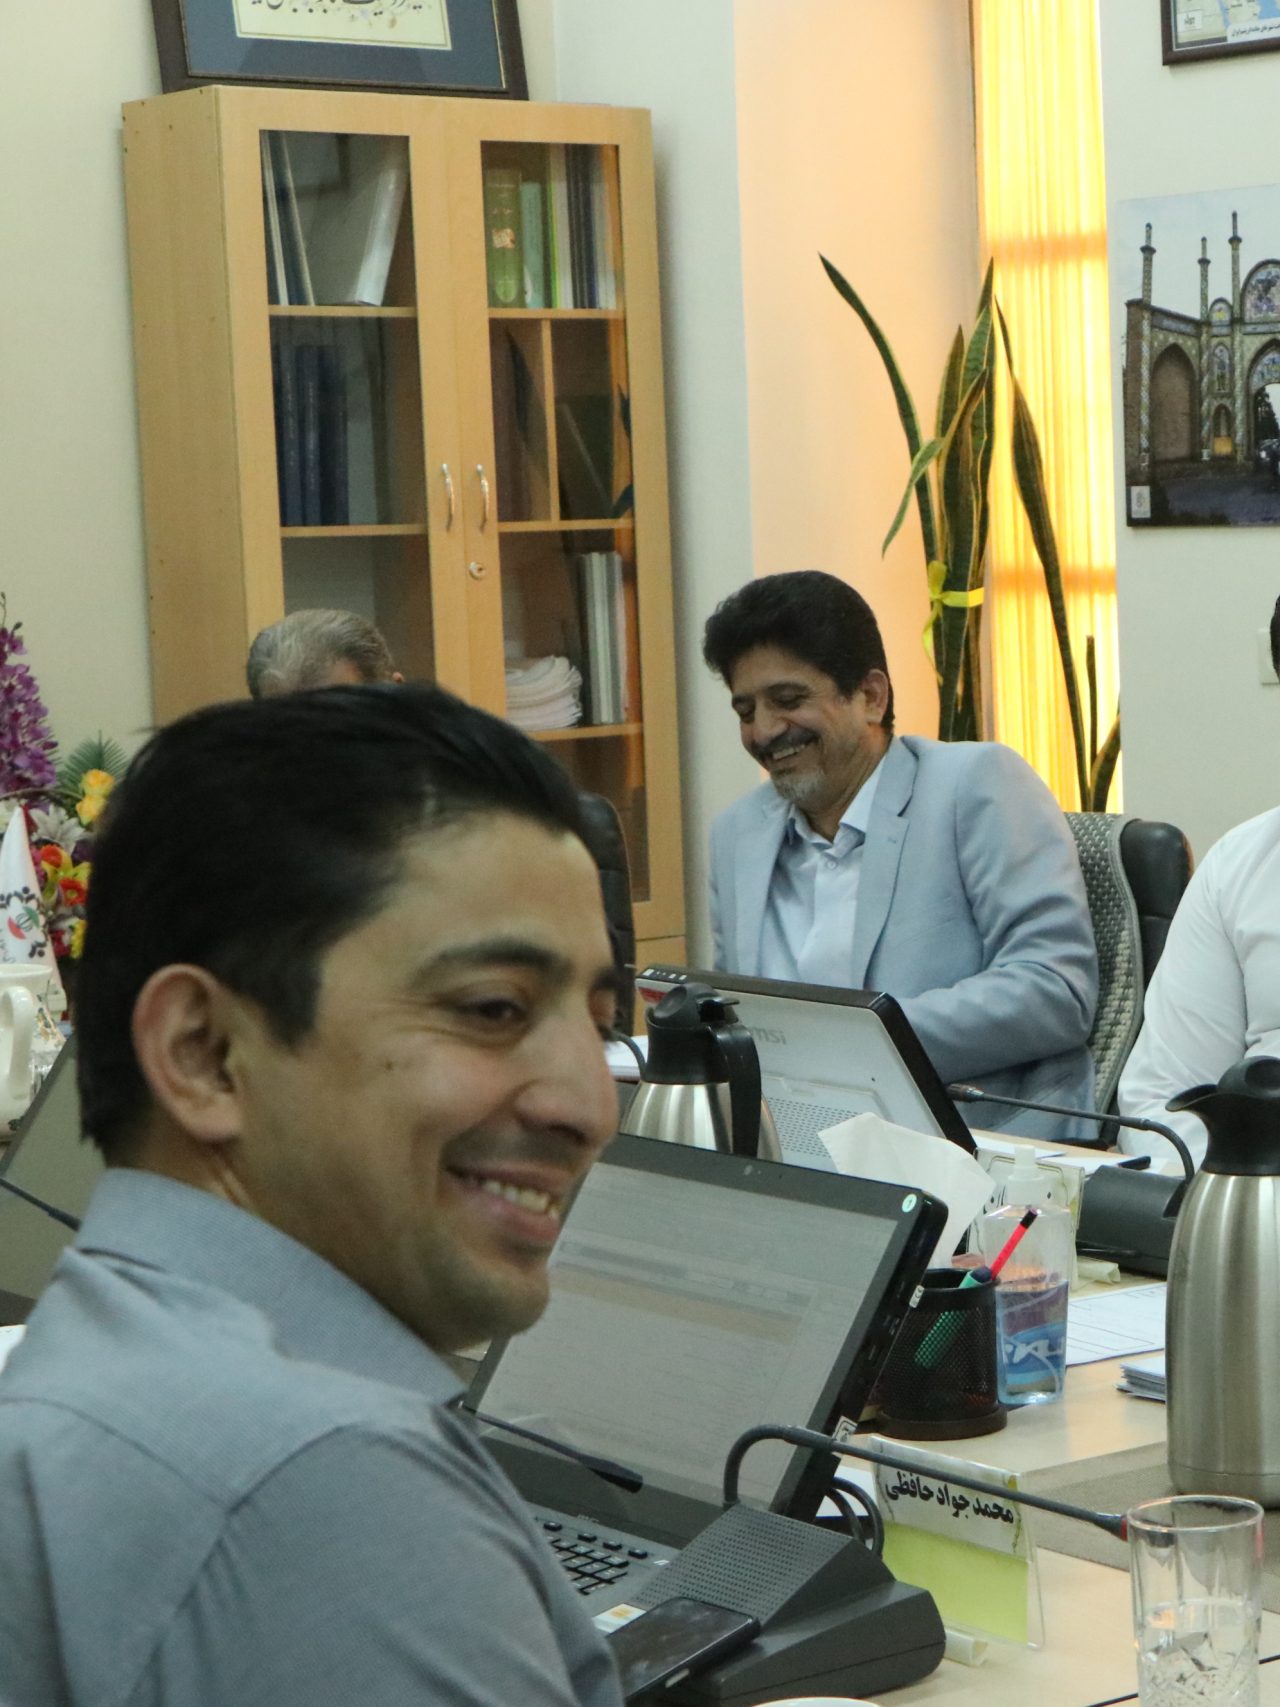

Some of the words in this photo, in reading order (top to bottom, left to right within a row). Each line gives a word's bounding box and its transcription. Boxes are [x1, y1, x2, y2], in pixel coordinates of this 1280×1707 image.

[884, 1470, 934, 1501] حافظی
[935, 1483, 971, 1519] جواد
[972, 1498, 1014, 1524] محمد
